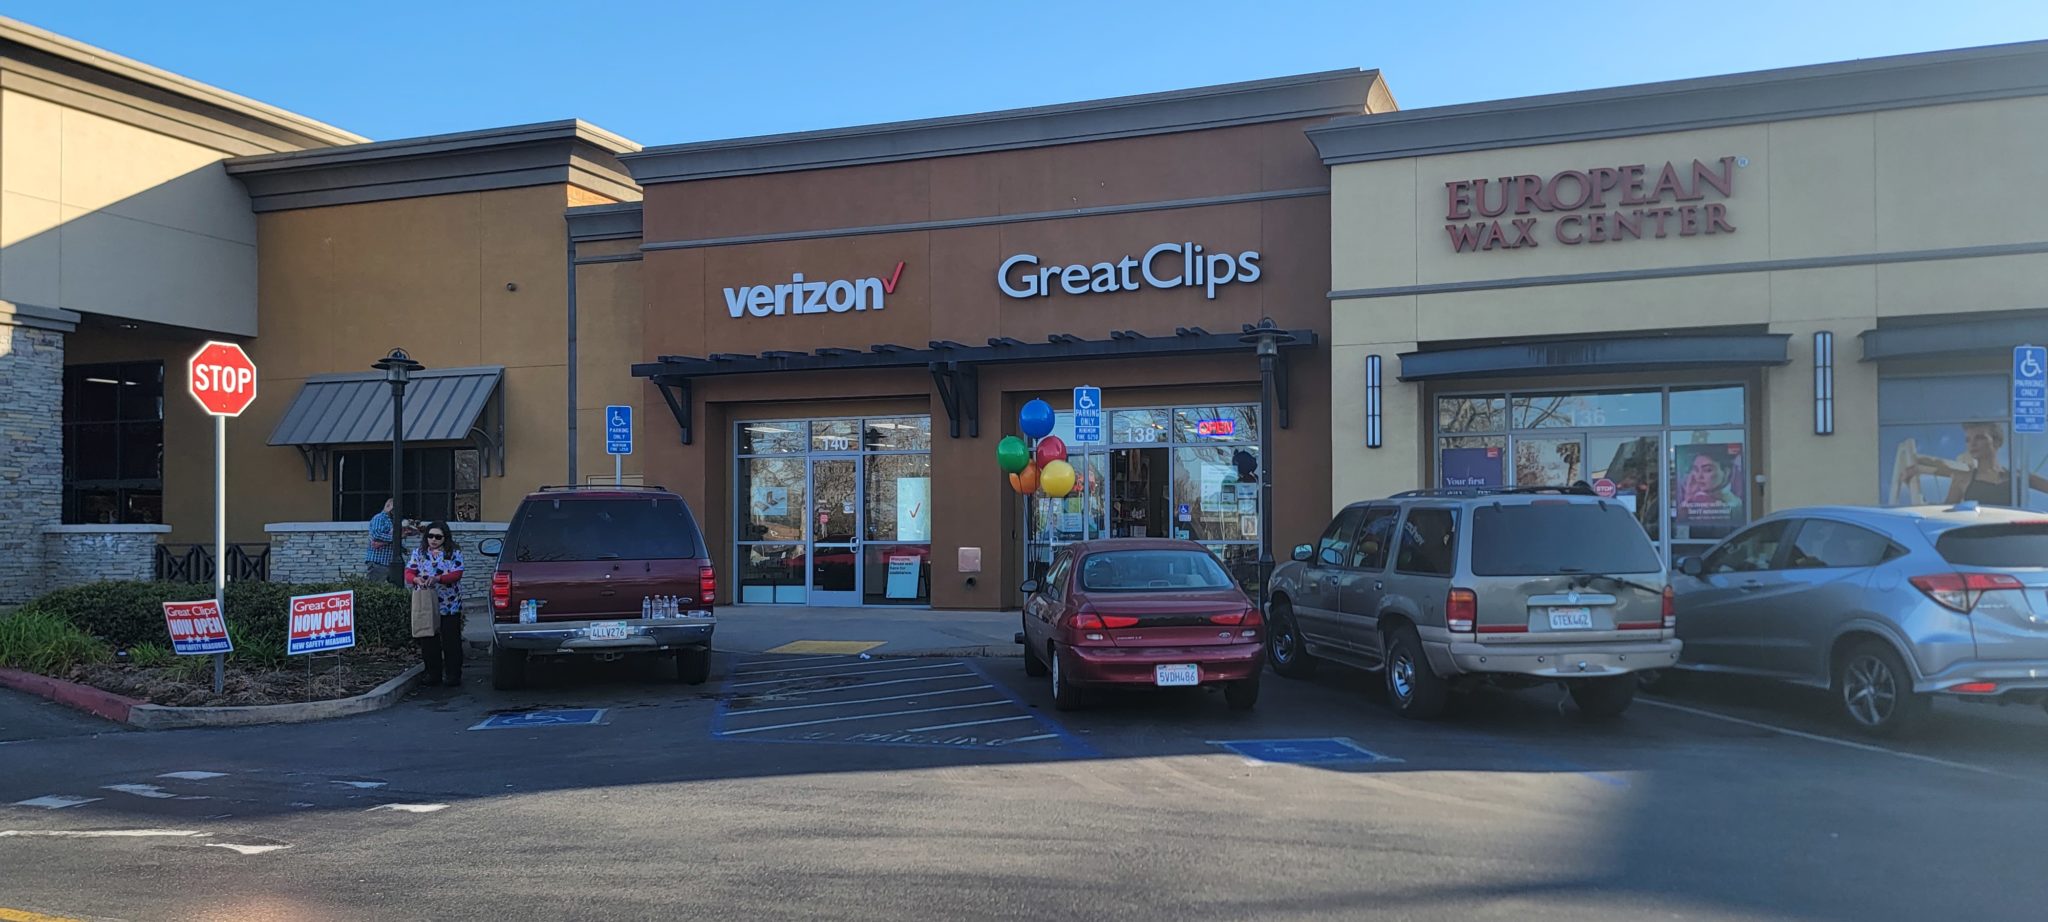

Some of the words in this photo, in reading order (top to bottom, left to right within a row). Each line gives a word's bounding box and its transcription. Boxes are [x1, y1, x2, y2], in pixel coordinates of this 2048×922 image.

[1445, 156, 1736, 221] EUROPEAN
[1444, 217, 1539, 253] WAX
[1555, 202, 1738, 246] CENTER
[723, 272, 885, 318] verizon
[195, 363, 252, 394] STOP
[1076, 409, 1100, 417] PARKING
[1571, 408, 1606, 427] 136
[1080, 418, 1096, 426] ONLY
[1199, 421, 1234, 435] OPEN
[1127, 427, 1156, 443] 138
[822, 439, 849, 450] 140
[1446, 477, 1467, 486] Your
[1468, 476, 1485, 486] first
[167, 606, 192, 617] Great
[192, 606, 217, 618] Clips
[294, 601, 326, 613] Great
[327, 597, 350, 610] Clips
[170, 619, 195, 635] NOW
[194, 617, 223, 634] OPEN
[293, 613, 323, 633] NOW
[324, 609, 351, 630] OPEN
[592, 627, 625, 638] 4LLV276
[291, 642, 305, 651] NEW
[305, 639, 325, 649] SAFETY
[325, 635, 352, 647] MEASURES
[1159, 671, 1196, 682] 5VDH486
